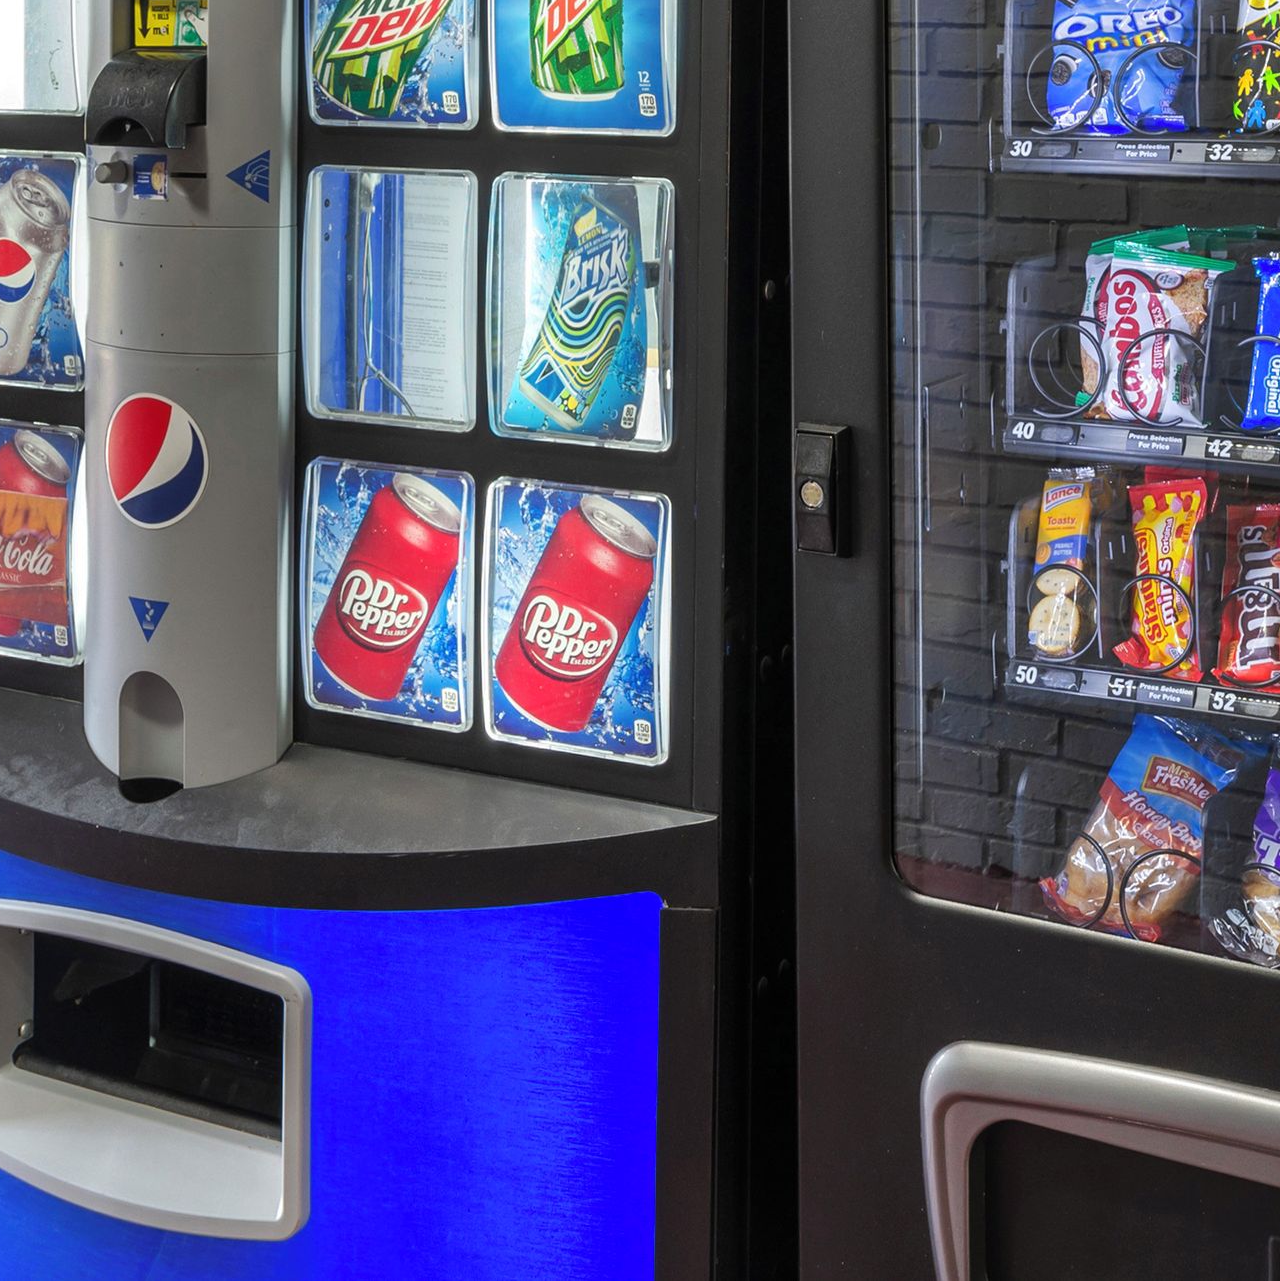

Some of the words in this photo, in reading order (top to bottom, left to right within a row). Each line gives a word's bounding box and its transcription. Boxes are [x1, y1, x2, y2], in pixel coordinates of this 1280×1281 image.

[152, 24, 170, 36] mei
[1054, 6, 1184, 41] OREO
[638, 70, 650, 83] 12
[445, 94, 458, 104] 170
[641, 95, 654, 105] 170
[1010, 141, 1032, 157] 30
[1210, 144, 1234, 161] 32
[1110, 280, 1149, 412] Combos
[1012, 421, 1035, 439] 40
[1208, 440, 1233, 458] 42
[1045, 485, 1082, 505] Lance
[1047, 515, 1076, 526] Toasty
[340, 569, 423, 635] Pepper
[371, 579, 409, 612] Dr
[523, 594, 612, 664] Pepper
[554, 605, 597, 640] Dr
[1015, 668, 1038, 685] 50
[444, 692, 456, 702] 150
[1111, 679, 1135, 697] 51
[1212, 692, 1237, 712] 52
[636, 723, 650, 733] 150
[1122, 790, 1172, 830] Honey
